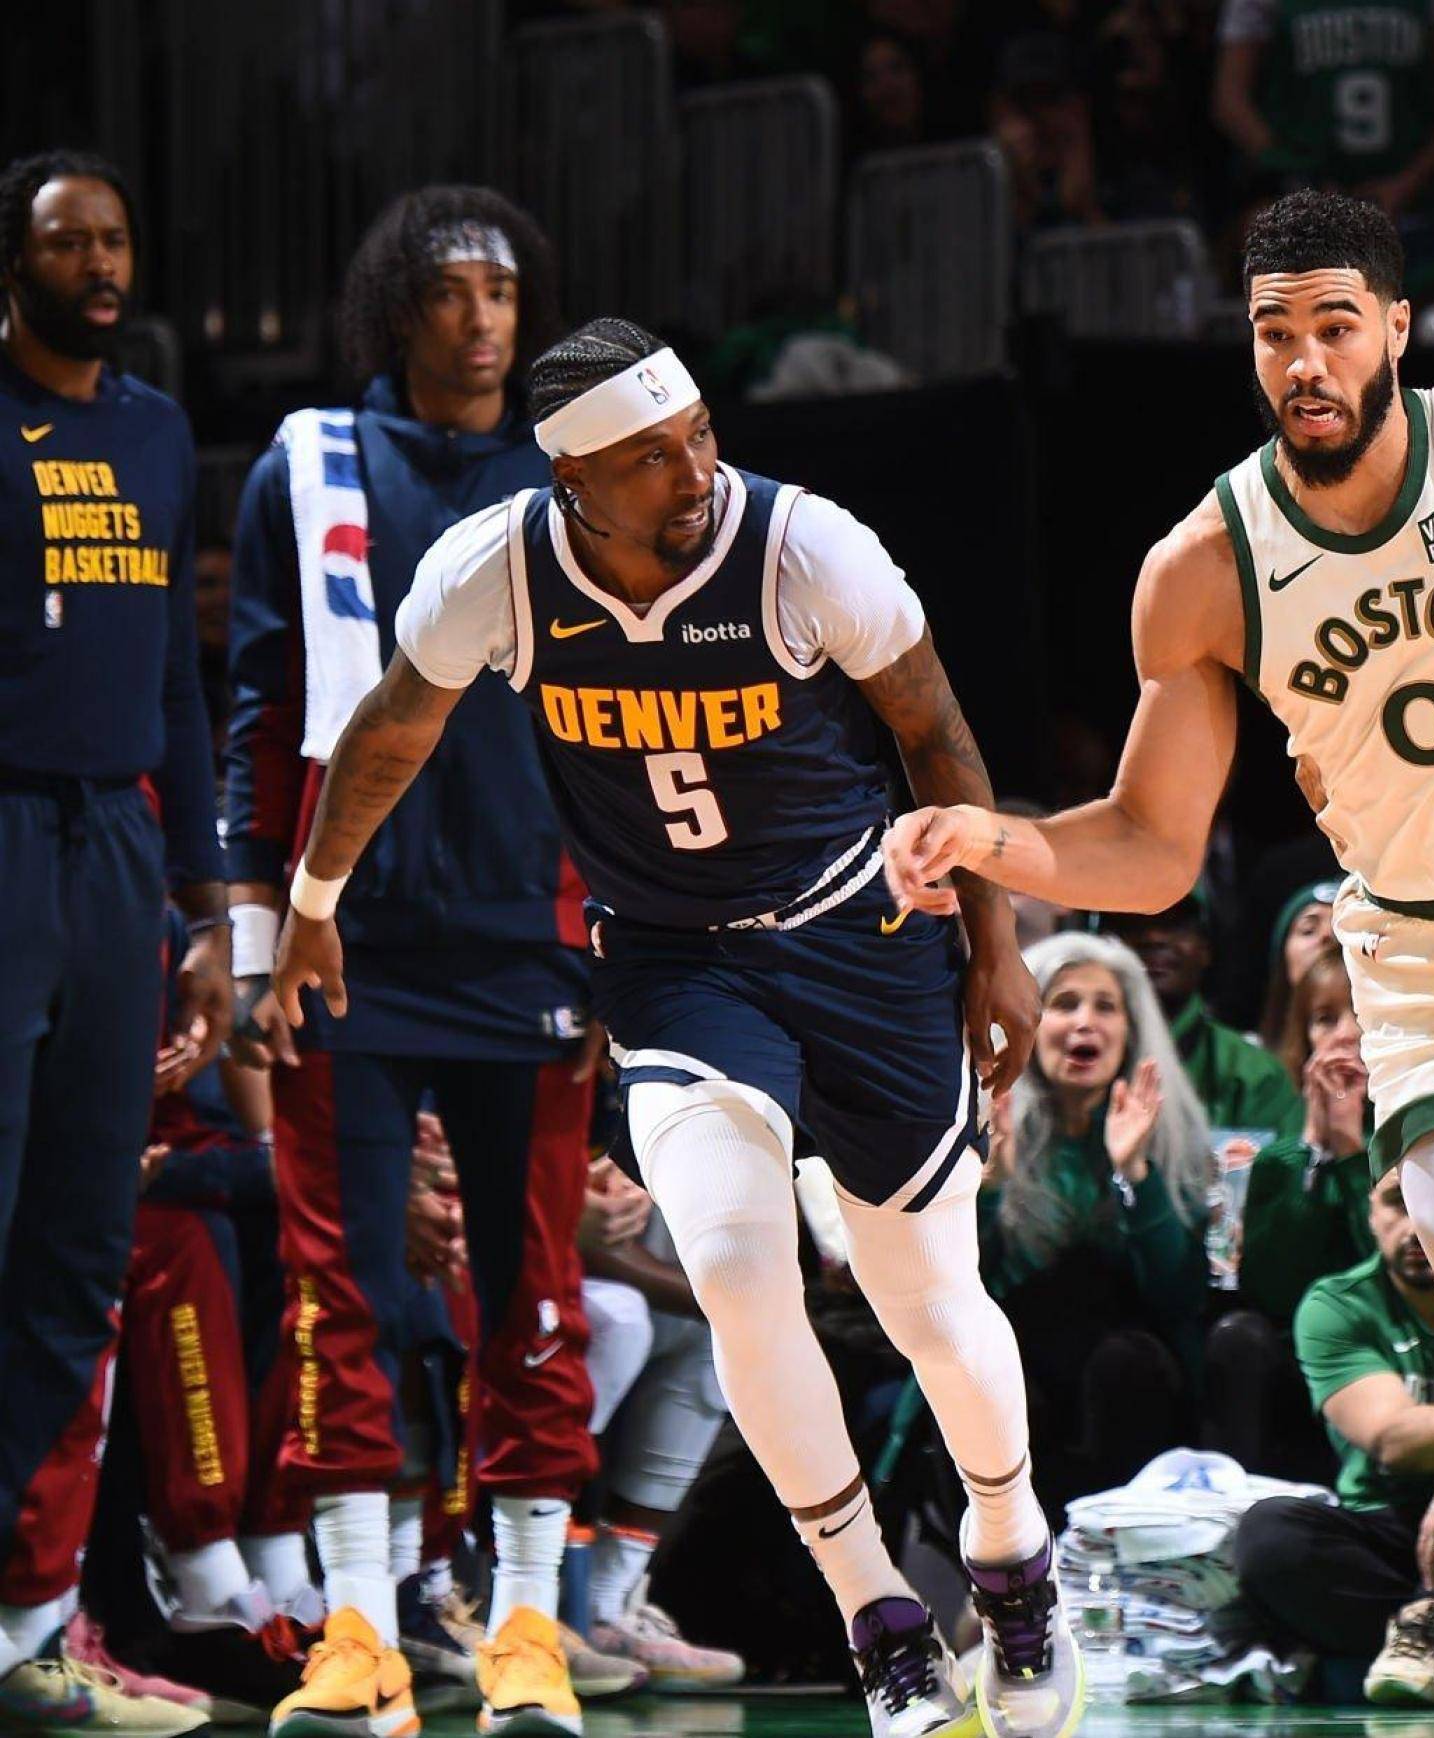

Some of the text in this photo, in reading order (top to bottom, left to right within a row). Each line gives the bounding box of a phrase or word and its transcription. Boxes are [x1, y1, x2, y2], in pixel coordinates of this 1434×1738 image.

[1334, 70, 1389, 153] 9
[32, 460, 119, 496] DENVER
[42, 502, 142, 540] NUGGETS
[44, 545, 170, 586] BASKETBALL
[682, 621, 751, 643] ibotta
[540, 682, 782, 750] DENVER
[645, 751, 729, 851] 5
